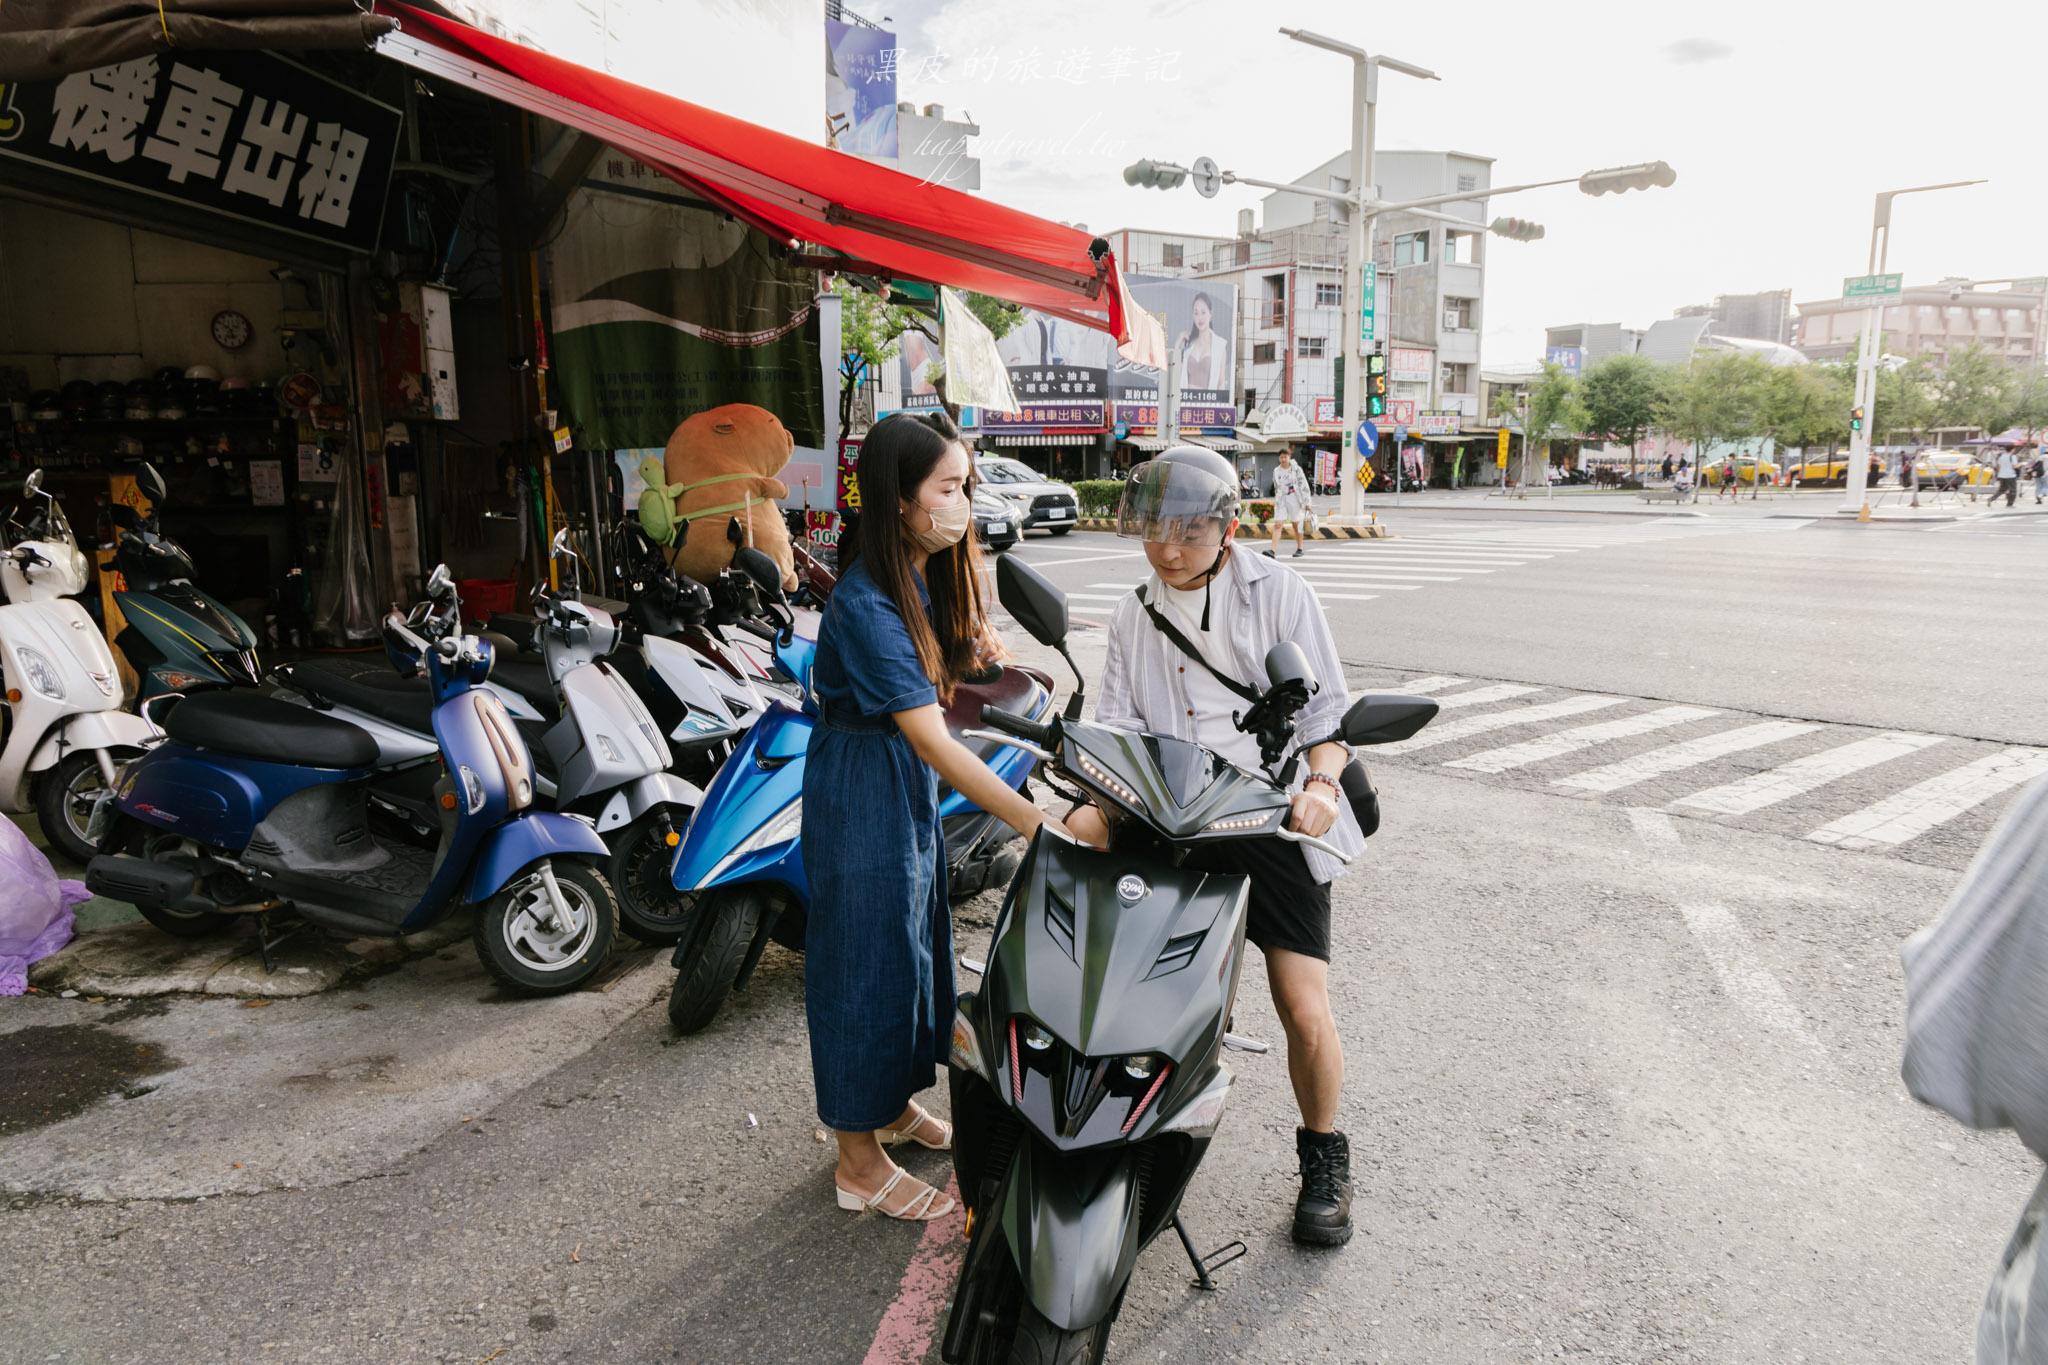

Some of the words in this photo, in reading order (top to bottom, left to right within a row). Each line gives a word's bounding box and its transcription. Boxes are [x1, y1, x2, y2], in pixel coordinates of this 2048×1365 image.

[48, 54, 369, 229] 機車出租
[1120, 881, 1142, 894] SYM
